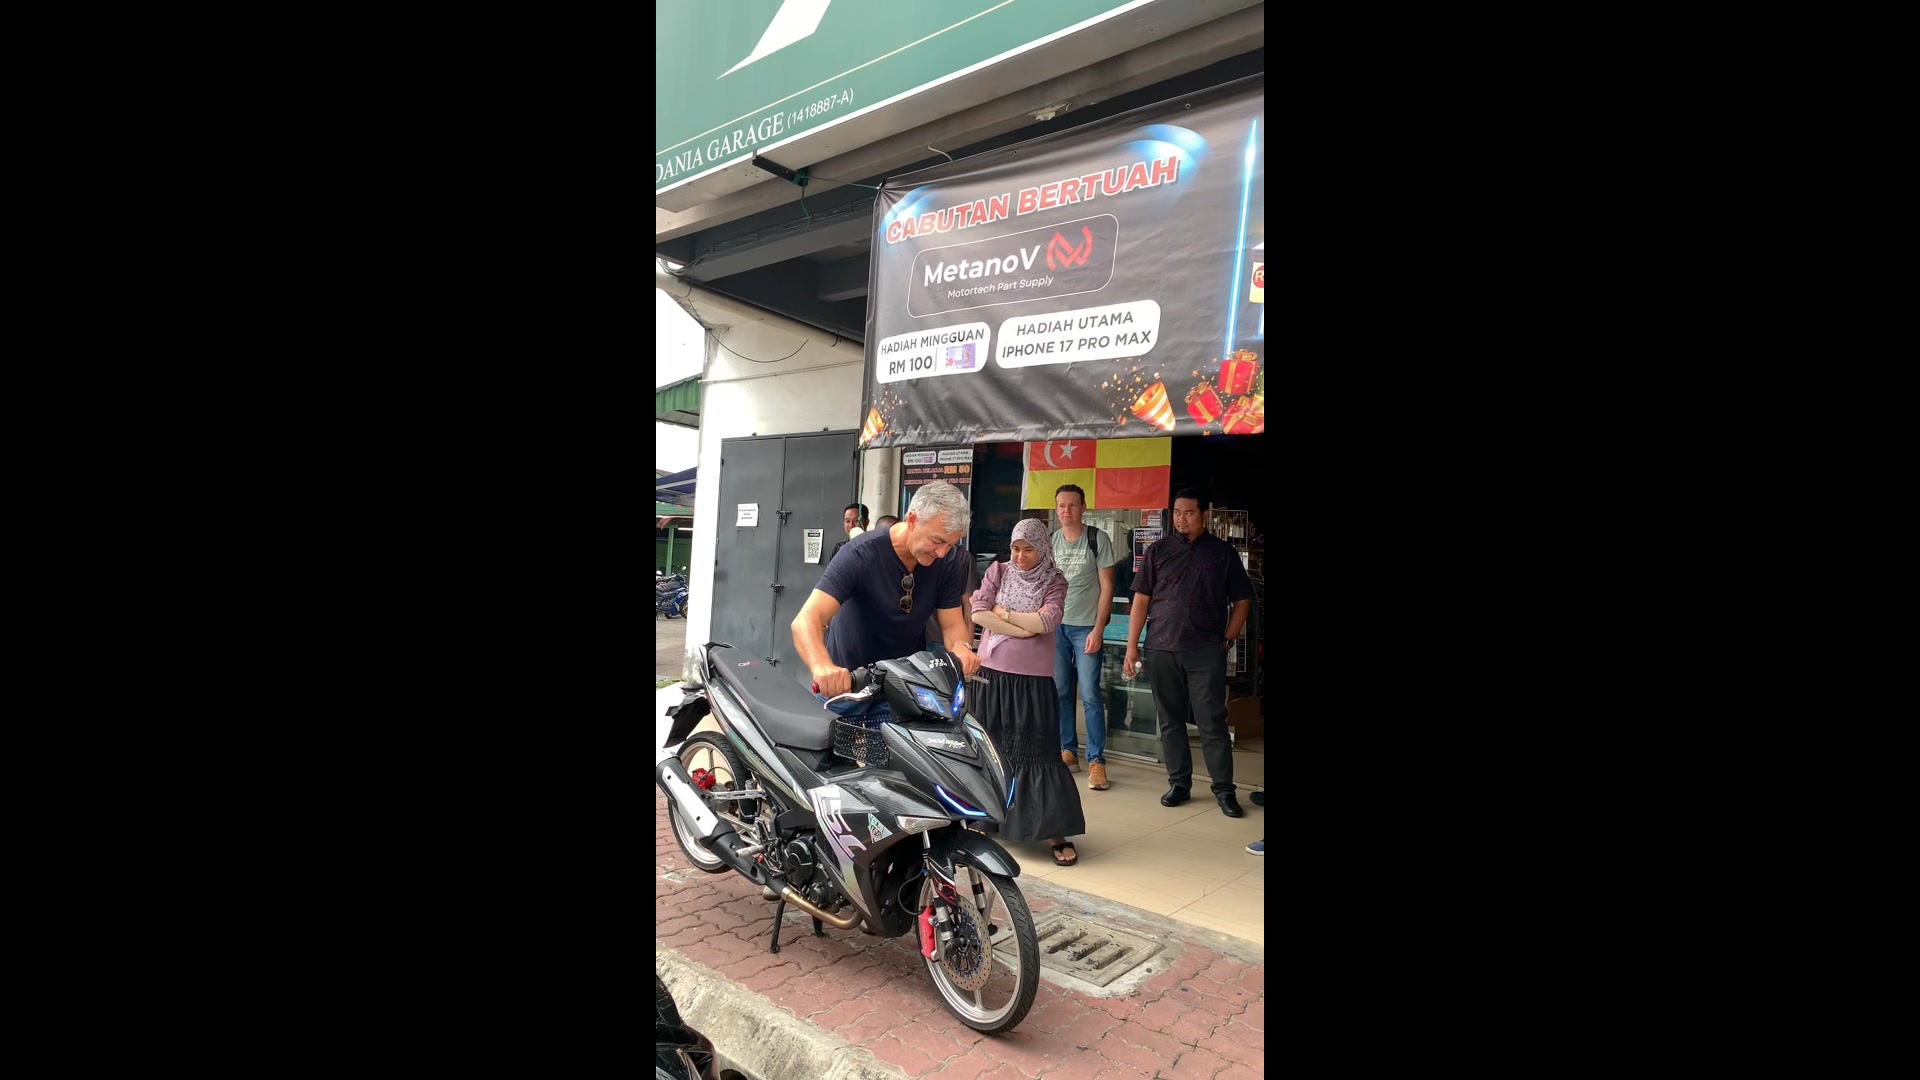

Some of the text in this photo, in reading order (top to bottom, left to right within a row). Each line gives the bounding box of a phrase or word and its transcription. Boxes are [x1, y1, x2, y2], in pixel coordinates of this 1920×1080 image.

[706, 111, 785, 162] GARAGE
[787, 87, 855, 129] (1418887-A)
[886, 155, 1179, 244] CABUTAN BERTUAH
[924, 245, 1041, 287] MetanoV
[947, 274, 1054, 299] Motortech Part Supply
[1016, 311, 1134, 337] HADIAH UTAMA
[881, 328, 985, 355] HADIAH MINGGUAN
[1002, 330, 1152, 358] IPHONE 17 PRO MAX
[889, 355, 933, 375] RM 100
